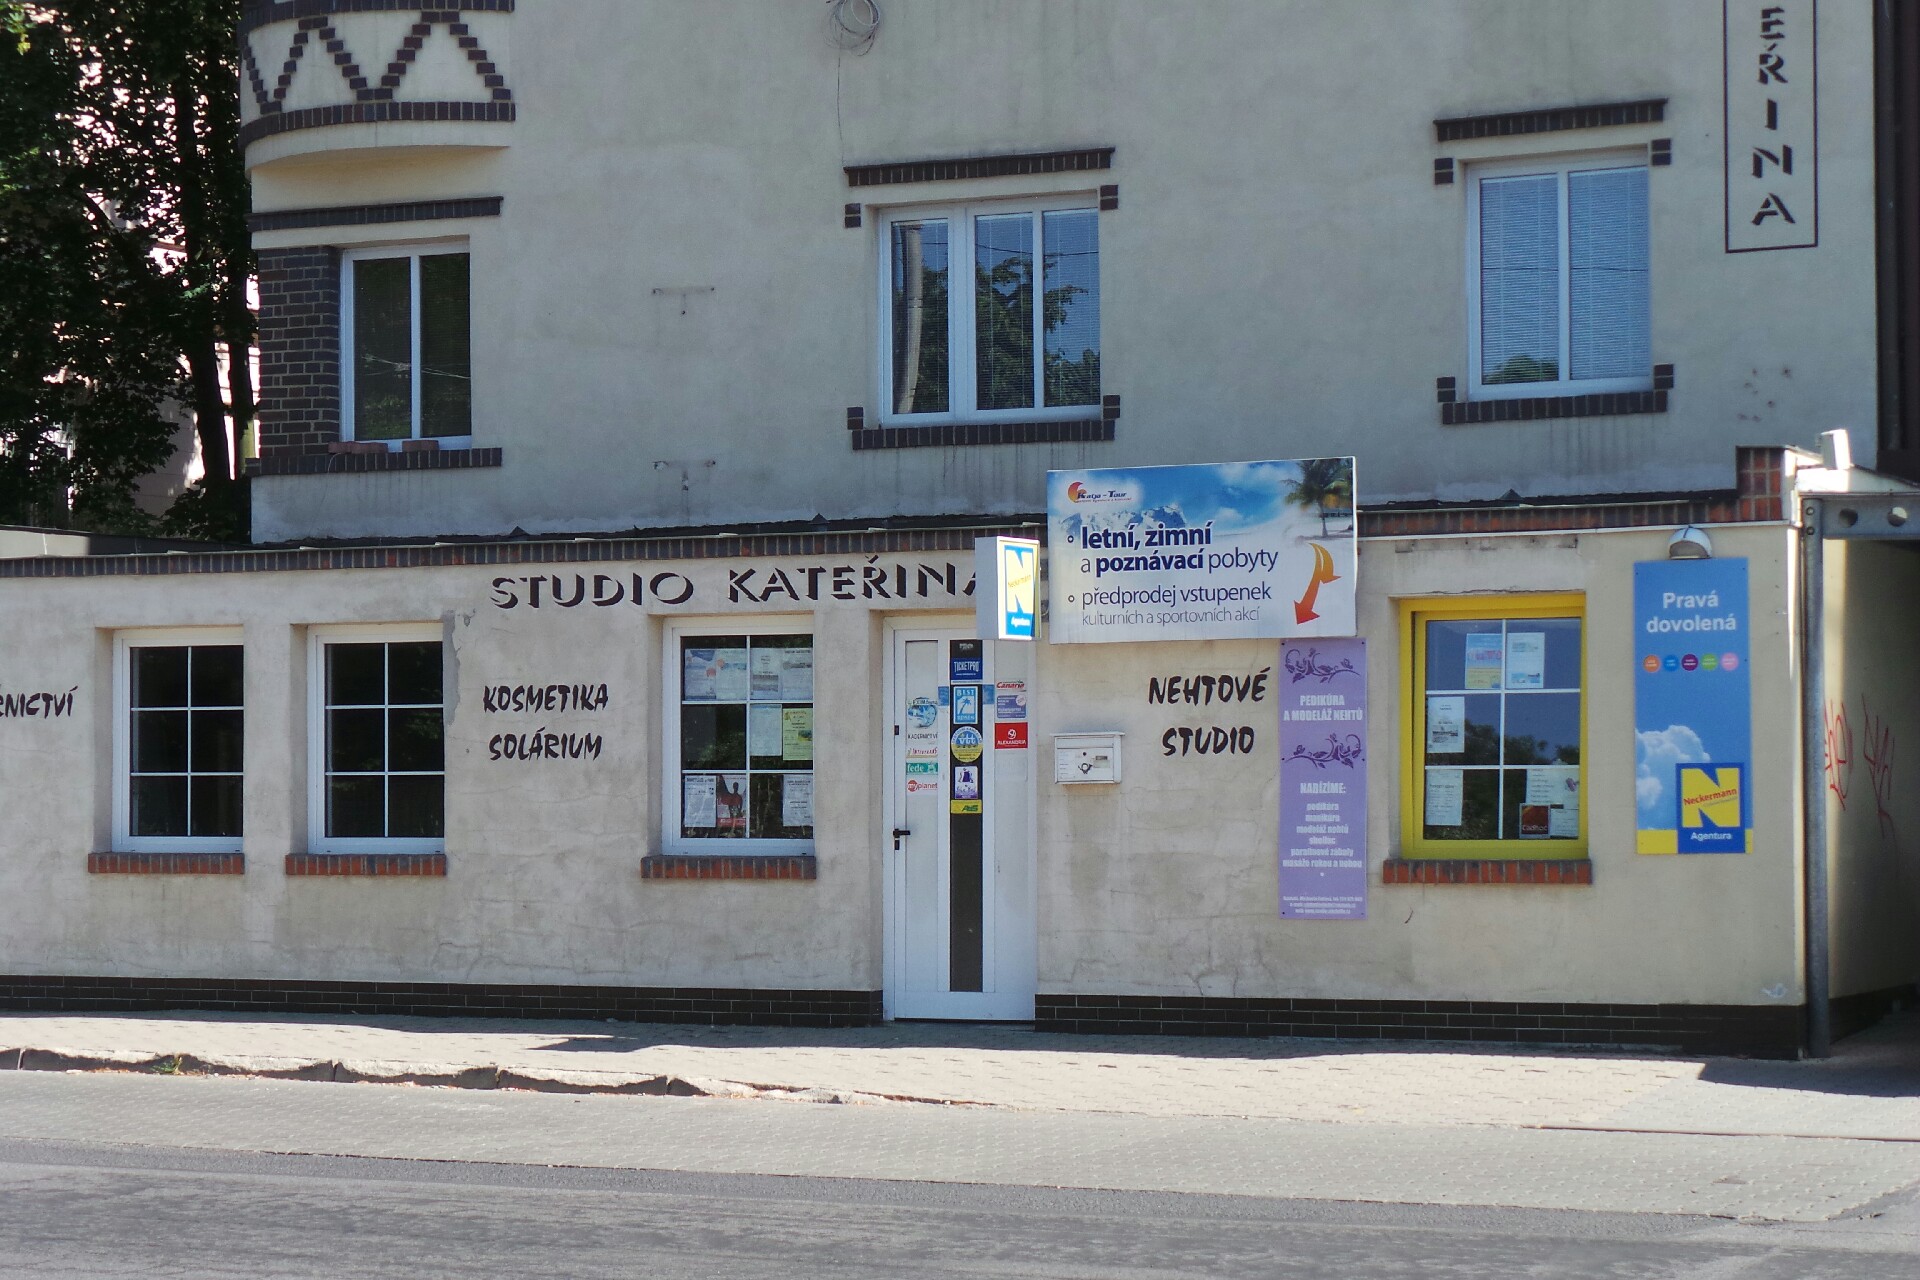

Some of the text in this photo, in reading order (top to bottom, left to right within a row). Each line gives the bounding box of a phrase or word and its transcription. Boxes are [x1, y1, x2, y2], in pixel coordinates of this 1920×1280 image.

[1081, 521, 1213, 550] letní, zimní
[1080, 547, 1278, 578] a poznávací pobyty
[490, 572, 694, 609] STUDIO
[1082, 581, 1272, 610] předprodej vstupenek
[1662, 589, 1719, 609] Pravá
[1082, 606, 1260, 627] kulturních a sportovních akcí
[1646, 613, 1737, 633] dovolená
[953, 661, 980, 672] TICKETPRO
[483, 684, 608, 713] KOSMETIKA
[1149, 666, 1271, 706] NEHTOVÉ
[0, 684, 78, 719] NICTVÍ
[1283, 710, 1290, 720] A
[1292, 708, 1332, 720] MODELÁŽ
[489, 727, 602, 761] SOLÁRIUM
[1162, 726, 1254, 757] STUDIO
[1683, 789, 1737, 805] Neckermann
[1690, 832, 1732, 841] Agentura
